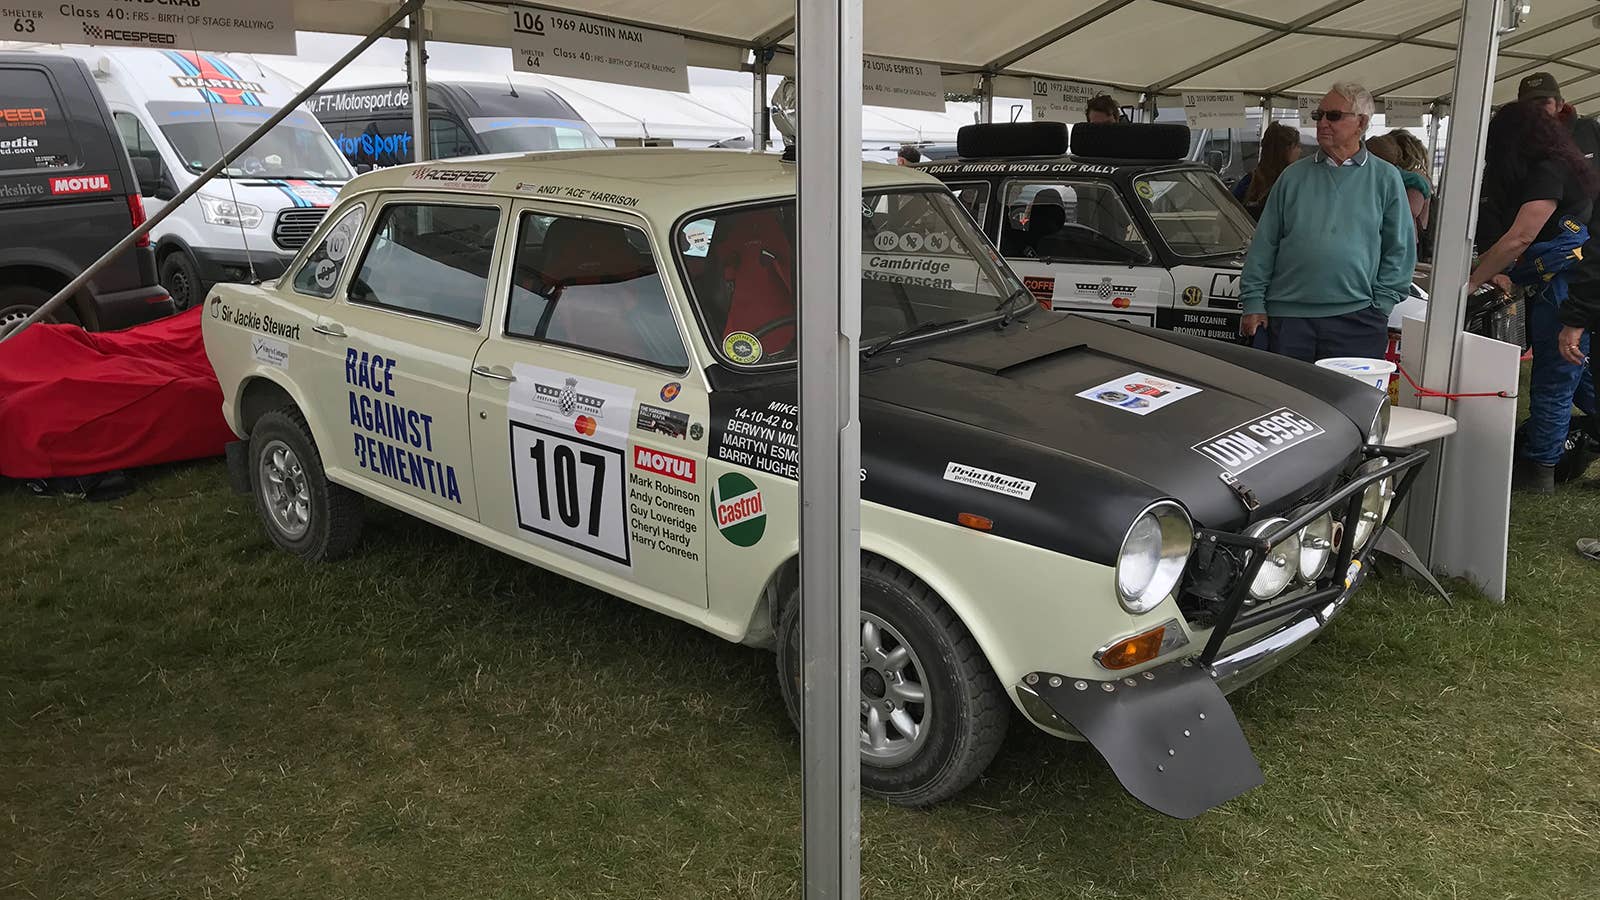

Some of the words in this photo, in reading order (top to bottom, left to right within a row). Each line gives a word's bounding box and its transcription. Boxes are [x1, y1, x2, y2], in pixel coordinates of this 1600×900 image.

[2, 9, 43, 18] SHELTER
[60, 4, 100, 18] Class
[106, 8, 130, 20] 40:
[133, 11, 149, 21] FRS
[158, 13, 184, 24] BIRTH
[188, 15, 200, 25] OF
[202, 17, 231, 28] STAGE
[233, 18, 274, 30] RALLYING
[514, 11, 544, 31] 106
[14, 19, 36, 33] 63
[104, 29, 175, 44] ACESPEED
[551, 17, 576, 31] 1969
[579, 22, 616, 39] AUSTIN
[618, 29, 643, 43] MAXI
[521, 49, 544, 57] SHELTER
[527, 56, 540, 67] 64
[553, 48, 577, 59] Class
[873, 62, 892, 72] LOTUS
[894, 65, 914, 75] ESPRIT
[177, 77, 262, 92] MARTINI
[1033, 81, 1048, 93] 100
[424, 169, 496, 182] ACESPEED
[929, 164, 960, 174] DAILY
[962, 164, 1006, 172] MIRROR
[1008, 164, 1049, 172] WORLD
[1051, 164, 1077, 172] CUP
[1078, 165, 1119, 174] RALLY
[55, 177, 108, 192] MOTUL
[537, 186, 562, 195] ANDY
[565, 187, 590, 199] "ACE"
[590, 192, 640, 207] HARRISON
[878, 236, 894, 246] 106
[869, 256, 950, 275] Cambridge
[863, 271, 952, 289] Stereoscan
[222, 305, 233, 321] Sir
[234, 308, 260, 330] Jackie
[262, 315, 300, 340] Stewart
[1184, 314, 1198, 323] TISH
[1200, 316, 1227, 326] OZANNE
[1173, 326, 1206, 337] BRONWYN
[1207, 329, 1235, 340] BURRELL
[345, 347, 396, 397] RACE
[735, 407, 780, 427] 14-10-42
[781, 419, 793, 430] to
[768, 401, 798, 416] MIKE
[349, 391, 433, 452] AGAINST
[727, 419, 775, 441] BERWYN
[722, 432, 768, 455] MARTYN
[1202, 431, 1268, 467] UDM
[1248, 411, 1314, 445] 999G
[637, 450, 693, 478] MOTUL
[719, 446, 754, 466] BARRY
[354, 432, 462, 505] DEMENTIA
[951, 465, 1031, 492] PrintMedia
[530, 438, 606, 537] 107
[630, 473, 652, 489] Mark
[655, 480, 700, 503] Robinson
[954, 474, 1024, 496] printmedialtd.com
[630, 488, 653, 506] Andy
[655, 496, 695, 517] Conreen
[718, 492, 762, 525] Castrol
[631, 503, 648, 519] Guy
[650, 509, 697, 533] Loveridge
[631, 518, 660, 537] Cheryl
[662, 528, 690, 547] Hardy
[632, 531, 656, 549] Harry
[658, 540, 699, 561] Conreen
